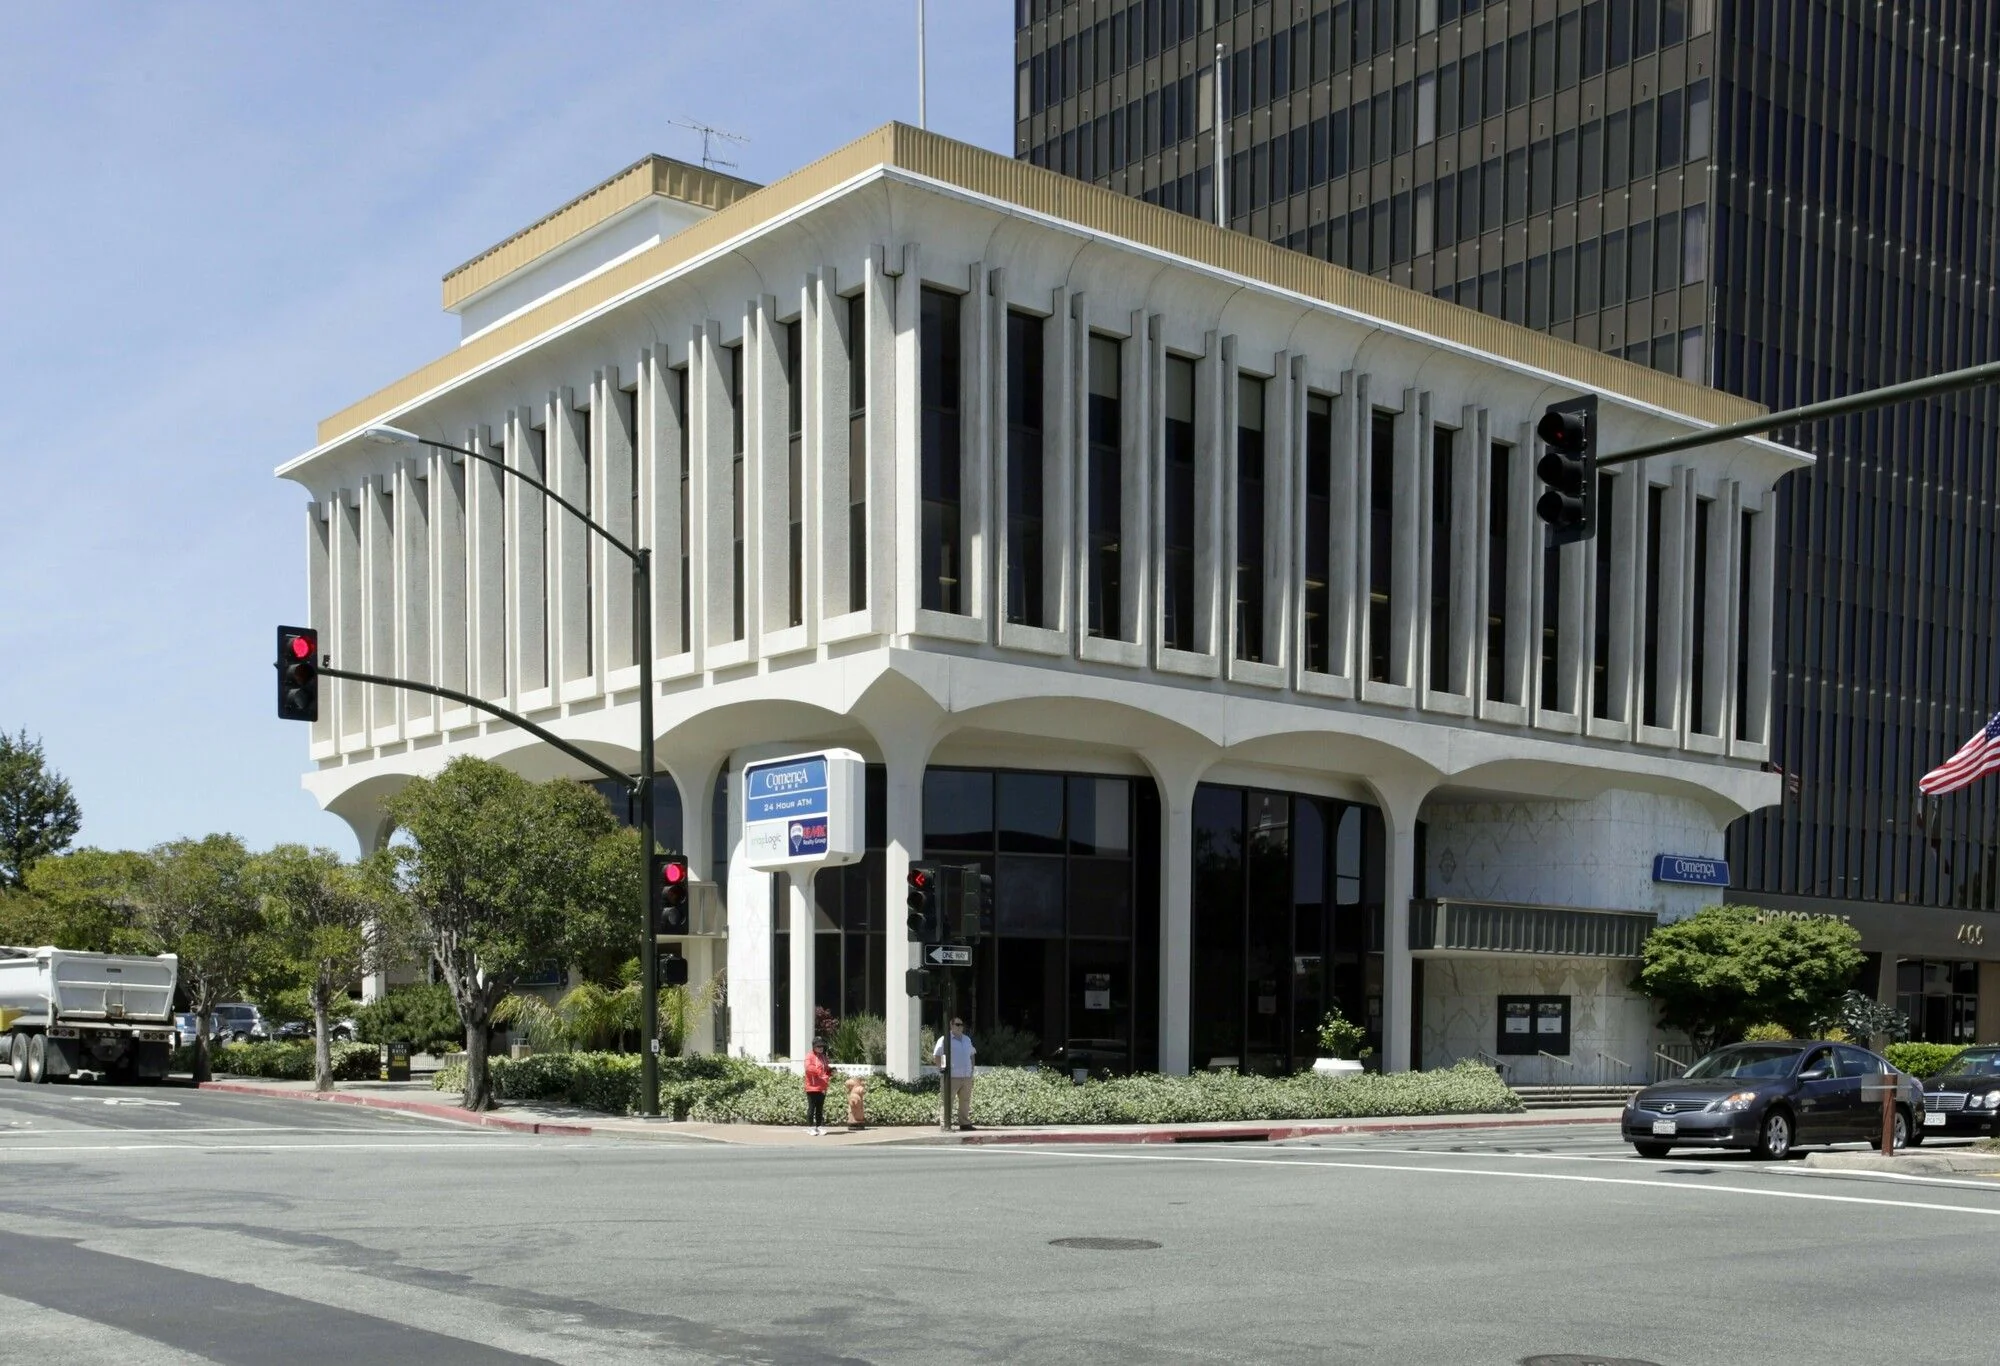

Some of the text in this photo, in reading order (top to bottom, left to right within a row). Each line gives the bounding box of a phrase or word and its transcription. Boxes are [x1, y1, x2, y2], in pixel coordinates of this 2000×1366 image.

[774, 783, 798, 791] BANK
[764, 804, 774, 812] 24
[797, 798, 812, 807] ATM
